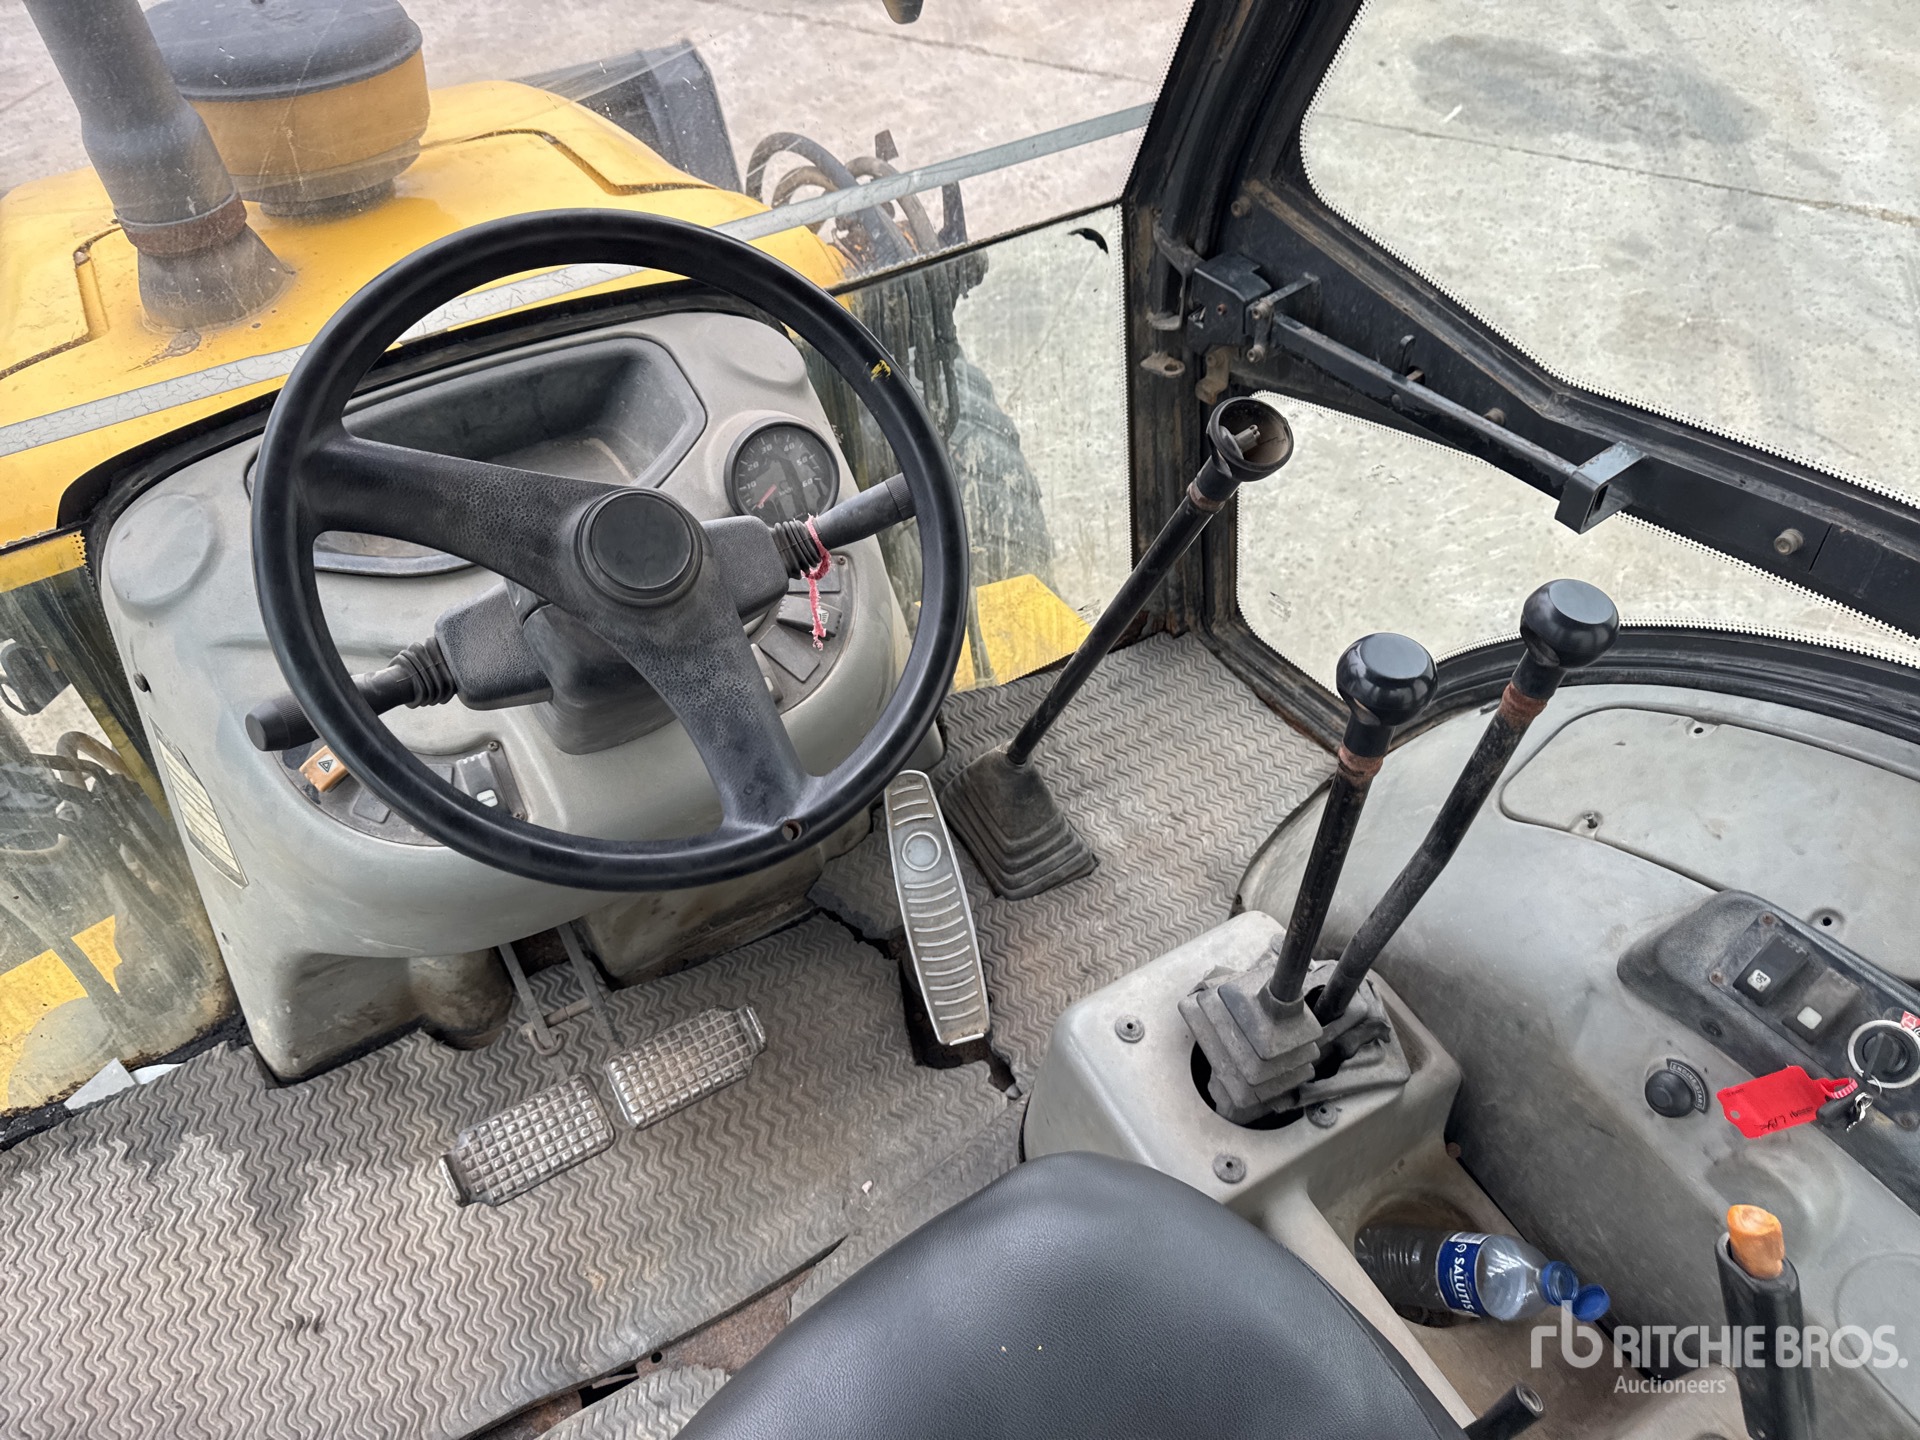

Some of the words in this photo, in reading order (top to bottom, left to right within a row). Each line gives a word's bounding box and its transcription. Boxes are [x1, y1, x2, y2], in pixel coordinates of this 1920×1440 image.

[761, 443, 773, 455] 30
[783, 442, 795, 452] 40
[747, 461, 759, 471] 20
[796, 456, 808, 466] 50
[747, 480, 757, 490] 10
[802, 477, 813, 488] 60
[1454, 1256, 1475, 1310] SALUTIS
